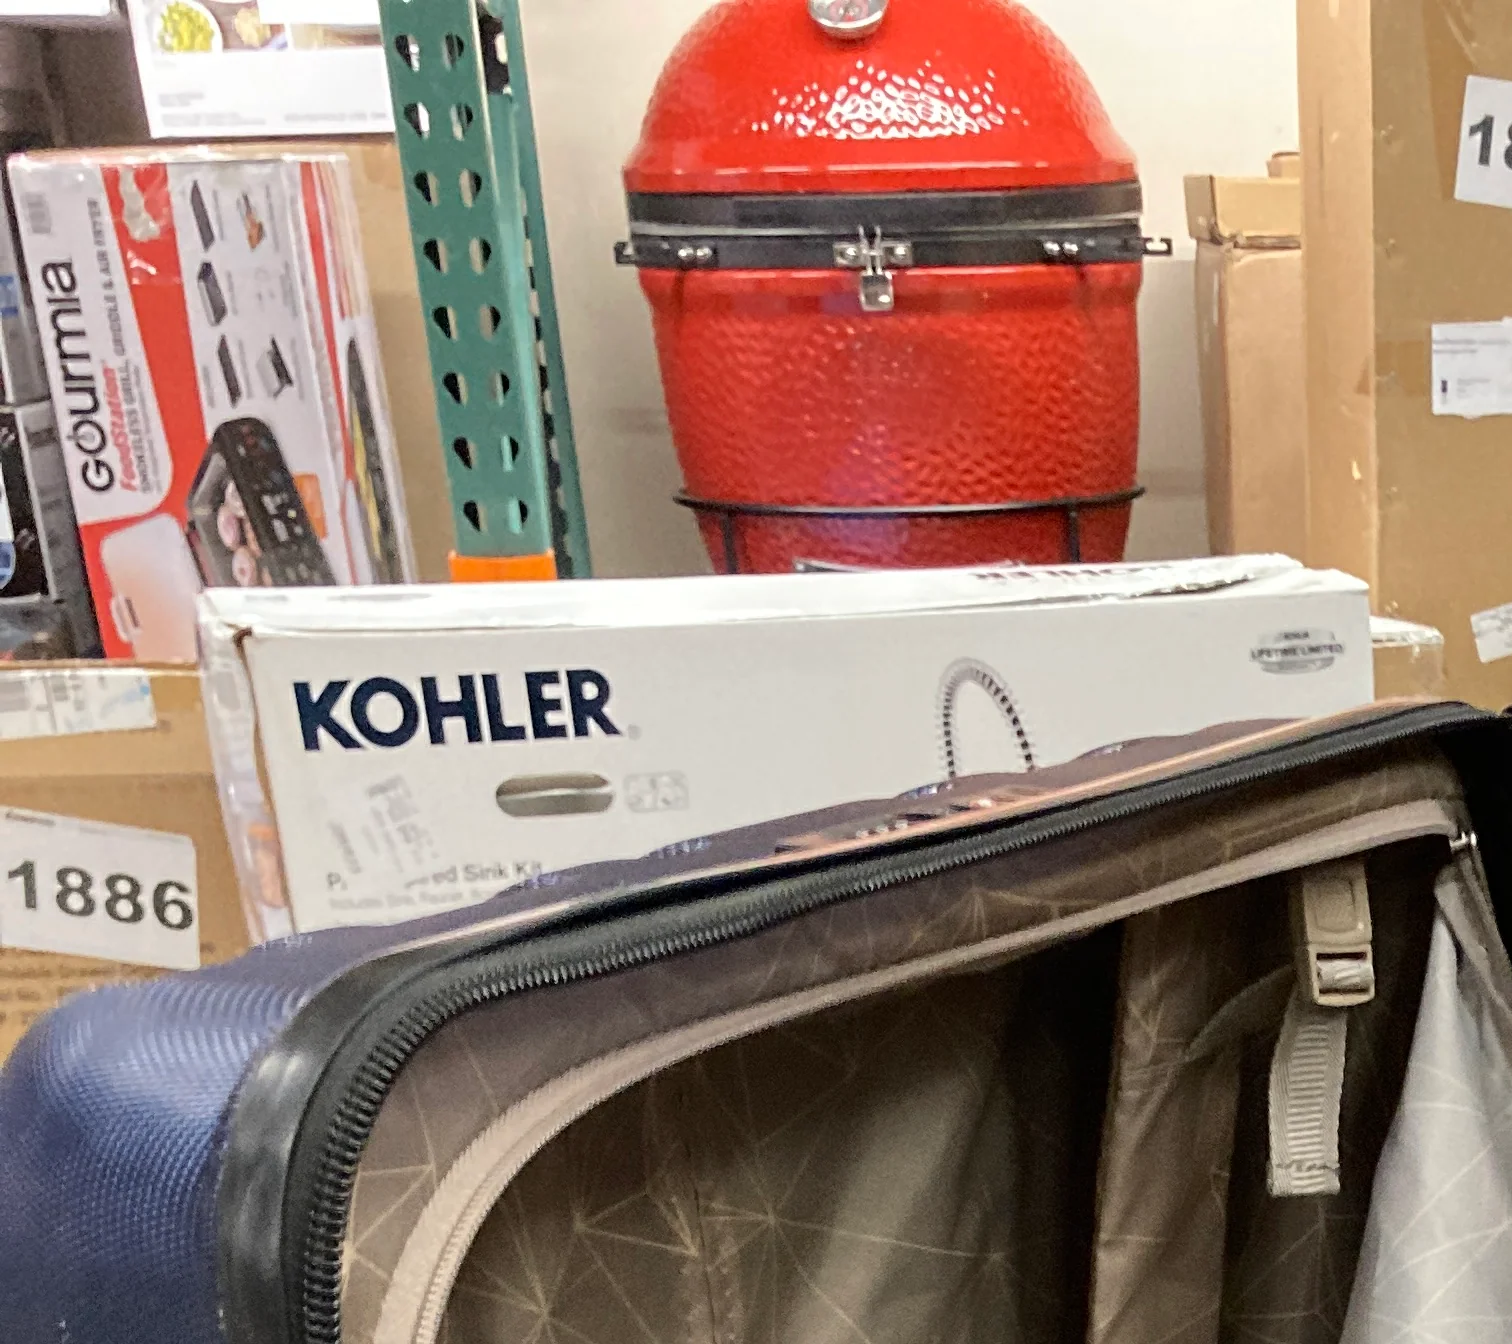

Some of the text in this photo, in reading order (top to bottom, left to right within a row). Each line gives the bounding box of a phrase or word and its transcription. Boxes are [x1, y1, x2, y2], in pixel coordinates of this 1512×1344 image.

[41, 258, 115, 492] Gourmia
[292, 668, 624, 752] KOHLER
[7, 860, 194, 931] 1886
